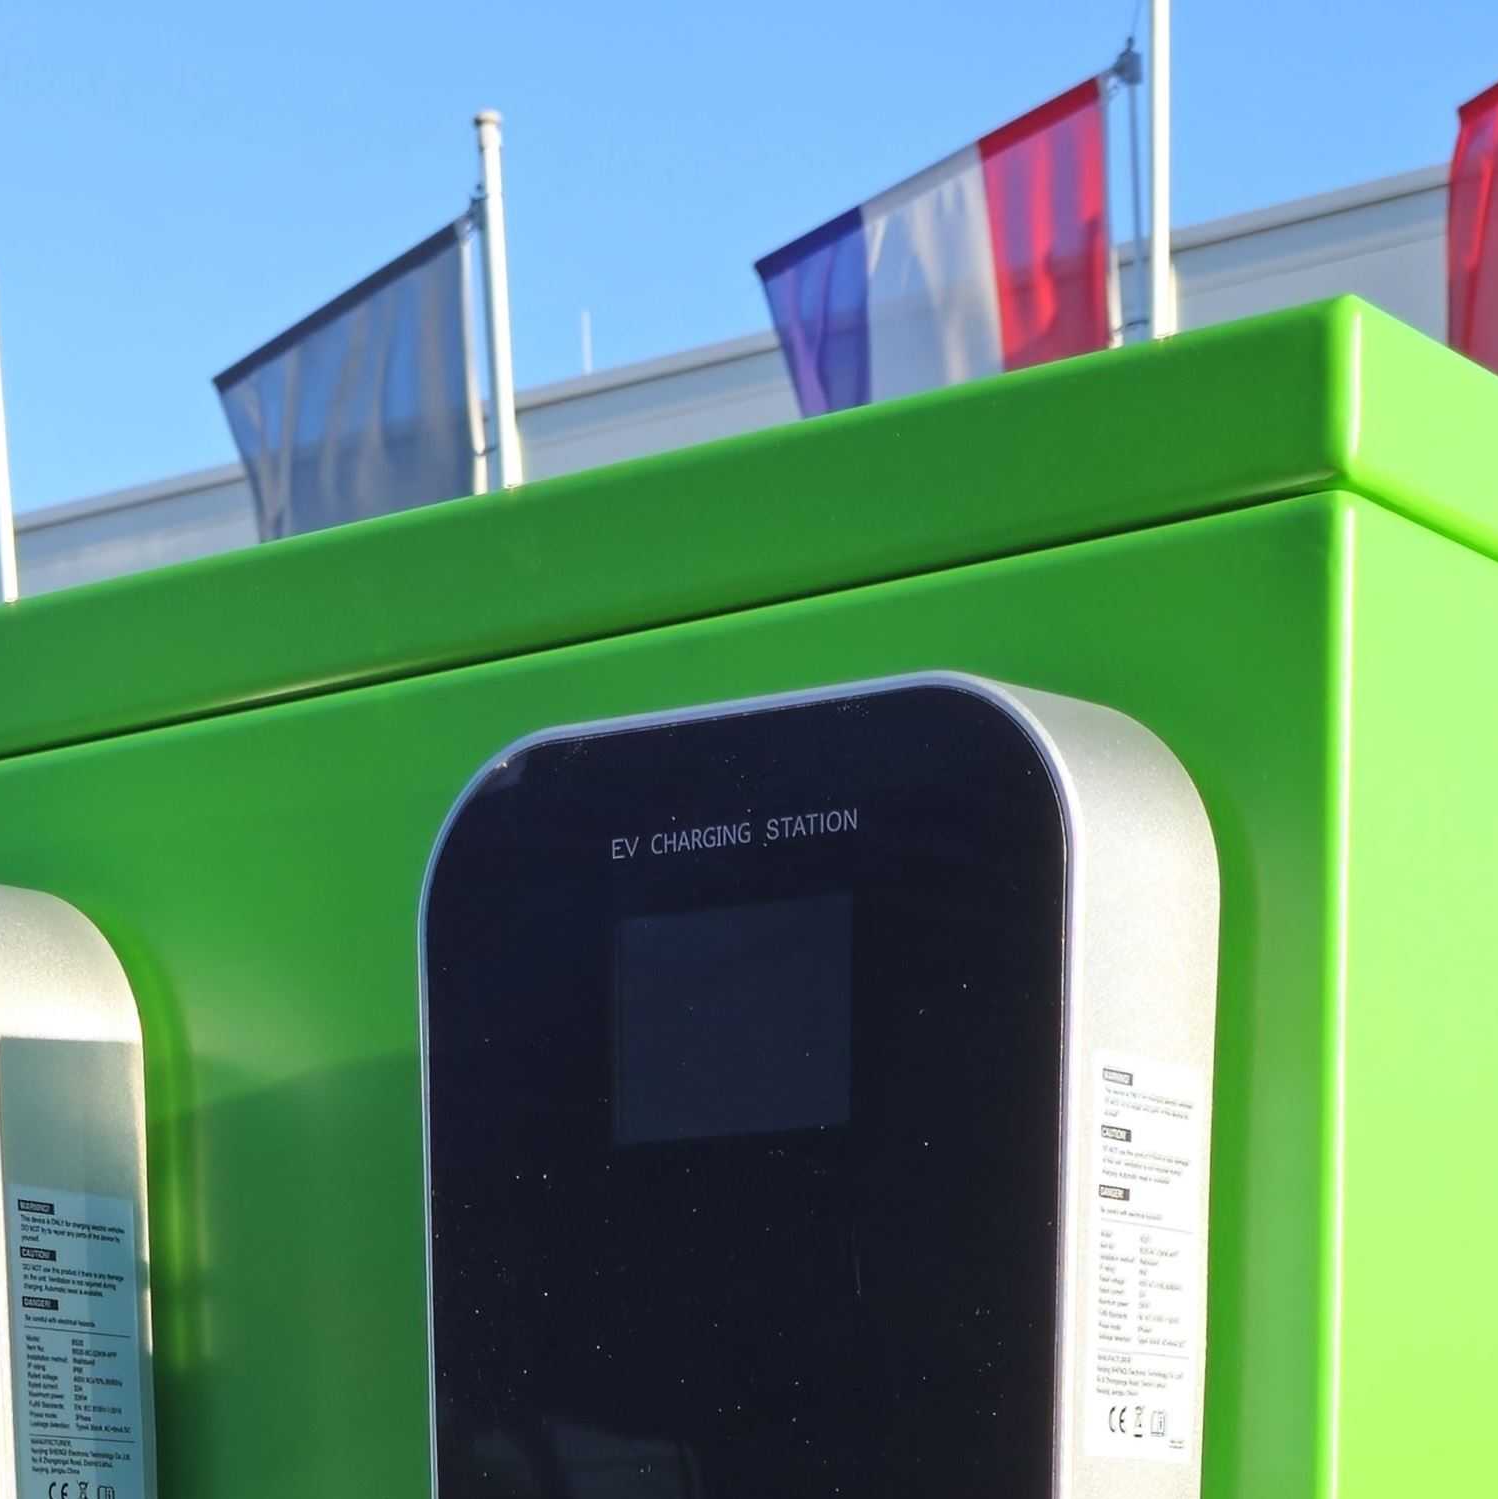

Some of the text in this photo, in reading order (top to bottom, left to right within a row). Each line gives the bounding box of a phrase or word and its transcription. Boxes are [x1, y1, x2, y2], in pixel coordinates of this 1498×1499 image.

[611, 808, 858, 859] EV CHARGING STATION
